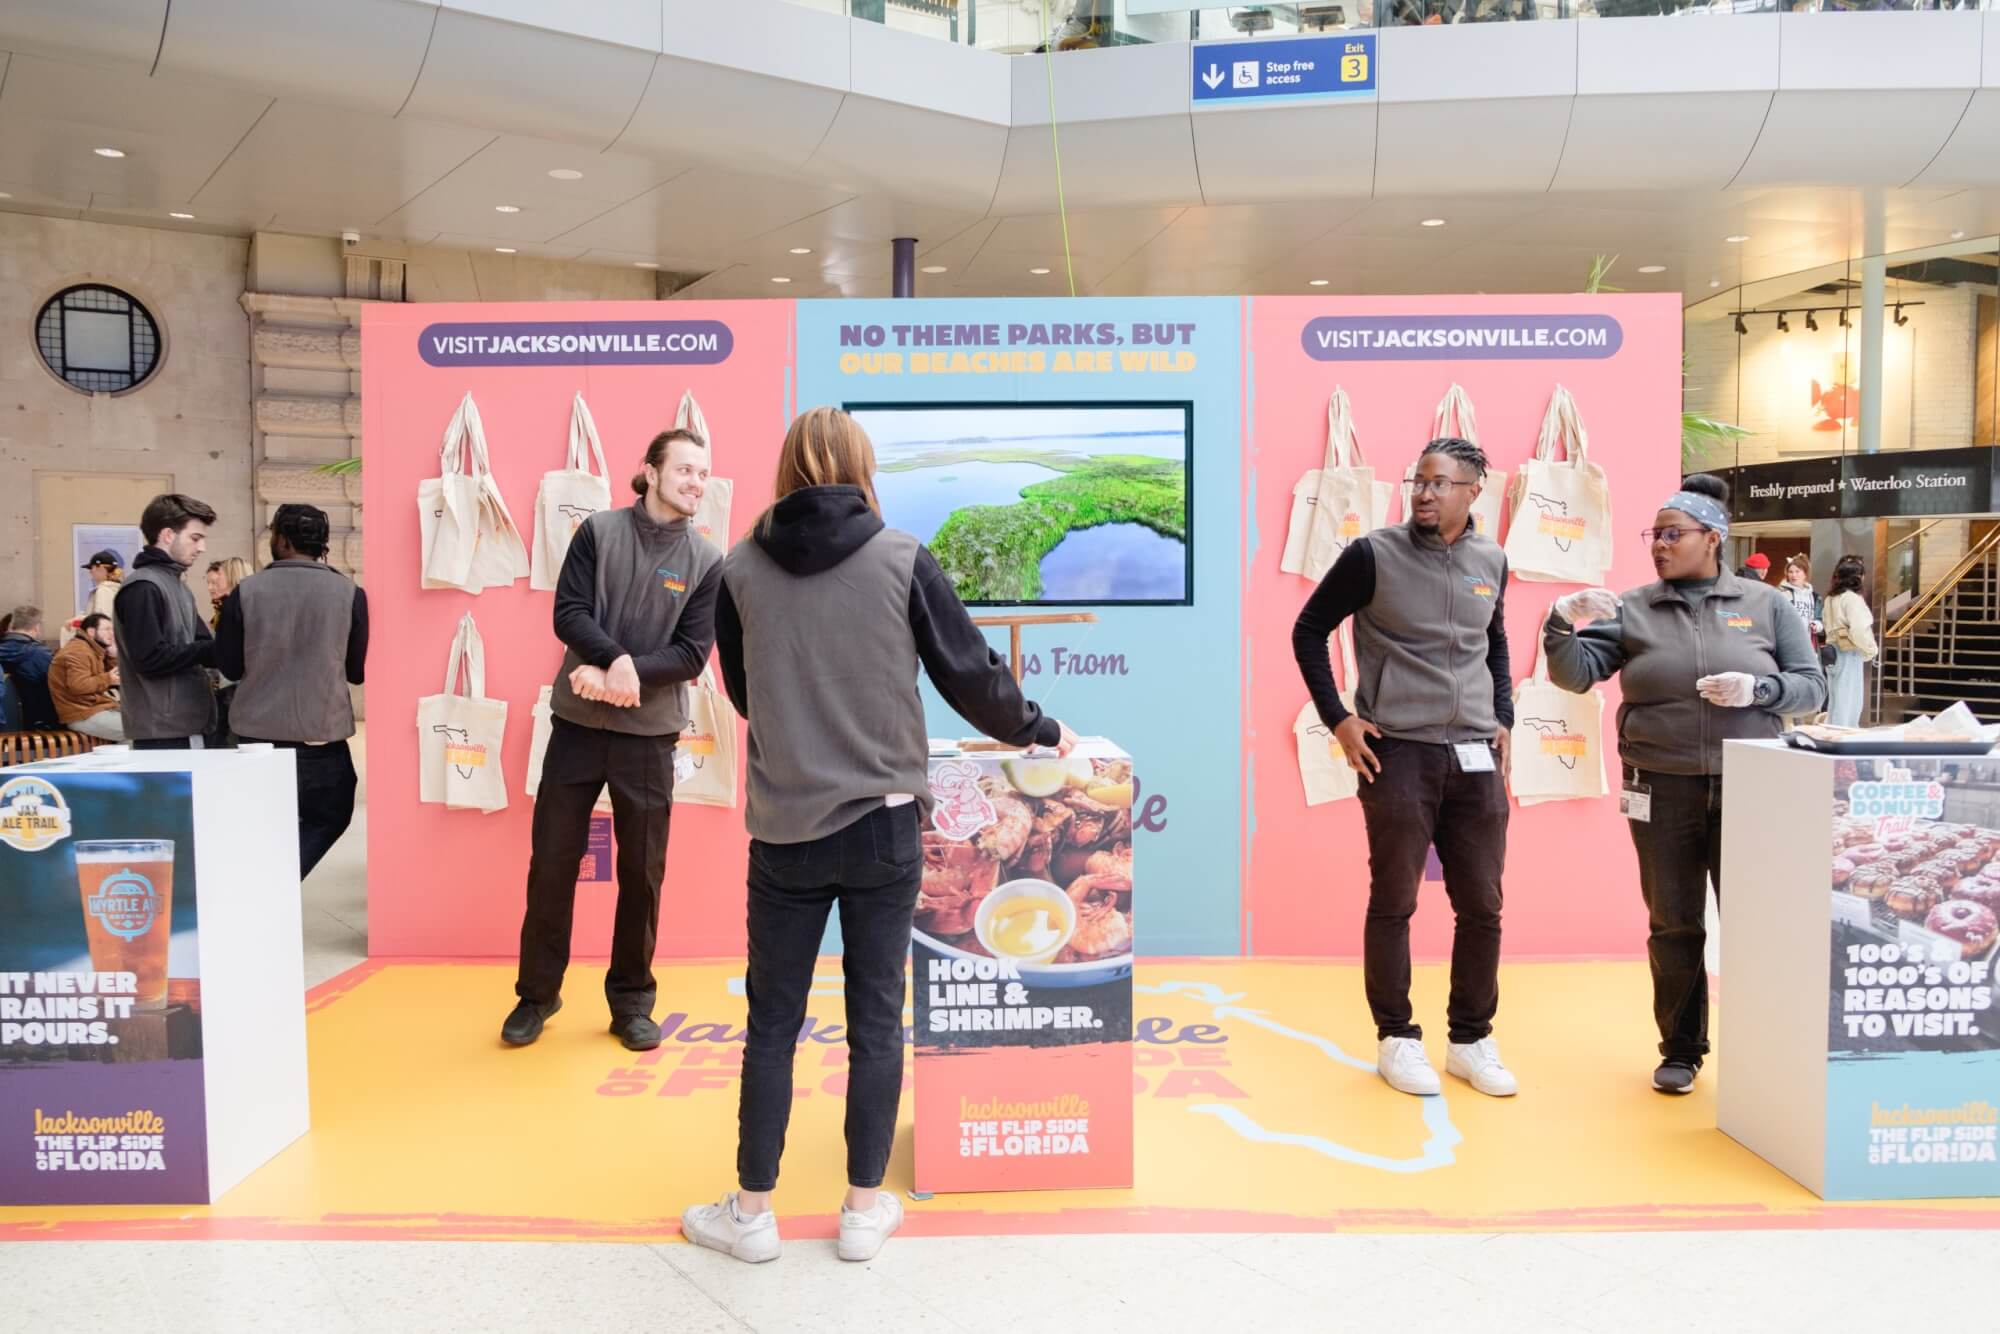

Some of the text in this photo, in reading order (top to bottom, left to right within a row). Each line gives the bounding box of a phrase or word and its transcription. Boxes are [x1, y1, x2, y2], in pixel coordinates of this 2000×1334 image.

[1344, 43, 1364, 53] Exit
[1266, 60, 1315, 73] Step free
[1348, 58, 1361, 78] 3
[1266, 75, 1301, 85] access
[433, 333, 718, 354] VISITJACKSONVILLE.COM
[840, 323, 1196, 347] NO THEME PARKS, BUT
[1317, 328, 1607, 348] VISITJACKSONVILLE.COM
[839, 350, 1197, 375] OUR BEACHES ARE WILD
[1750, 473, 1967, 499] Freshly prepared Waterloo Station
[1051, 647, 1129, 675] From
[17, 805, 39, 817] JAX
[1853, 800, 1939, 816] DONUTS
[2, 816, 58, 829] ALE TRAIL
[928, 957, 1021, 981] HOOK
[1948, 961, 1988, 985] OF
[0, 971, 138, 994] IT NEVER
[929, 982, 1029, 1007] LINE &
[1843, 987, 1992, 1011] REASONS
[1, 997, 135, 1019] RAINS IT
[929, 1006, 1103, 1032] SHRIMPER.
[2, 1022, 119, 1044] POURS.
[1843, 1013, 1980, 1037] TO VISIT.
[960, 1093, 1089, 1120] Jacksonville
[34, 1108, 165, 1135] Jacksonville
[960, 1121, 998, 1136] THE
[35, 1136, 74, 1149] THE
[1869, 1127, 1907, 1143] THE
